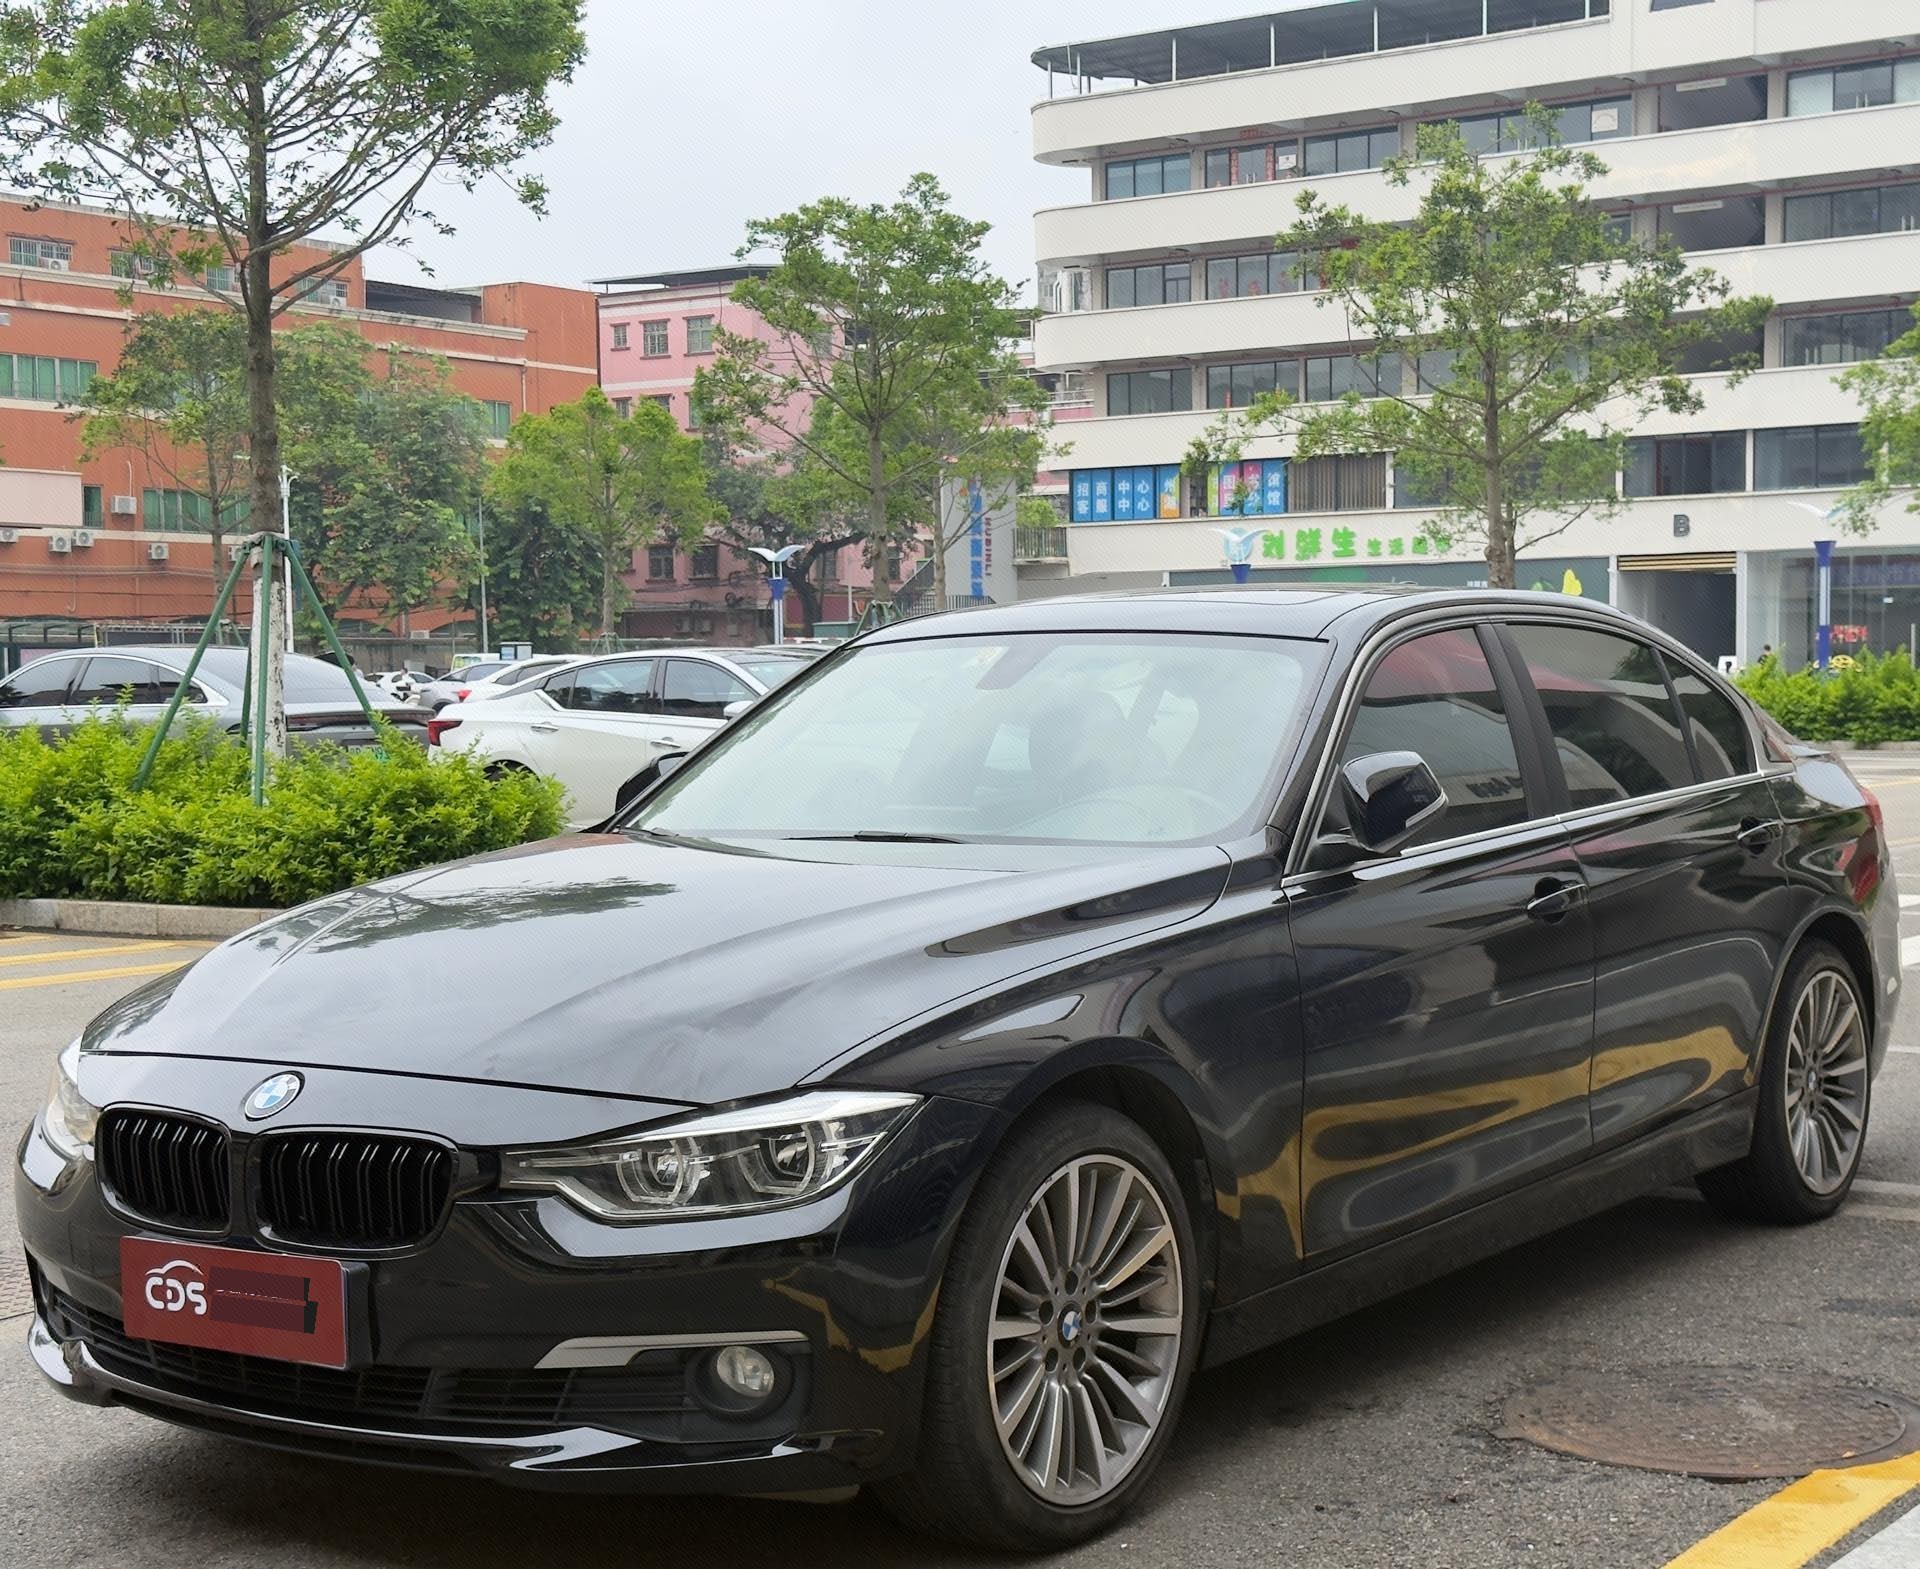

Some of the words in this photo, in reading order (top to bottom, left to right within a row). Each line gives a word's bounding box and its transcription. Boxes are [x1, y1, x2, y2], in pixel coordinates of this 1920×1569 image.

[1077, 480, 1150, 497] 招商中心
[1077, 498, 1150, 514] 客服中心
[1673, 514, 1690, 537] B
[145, 1276, 208, 1316] CDS
